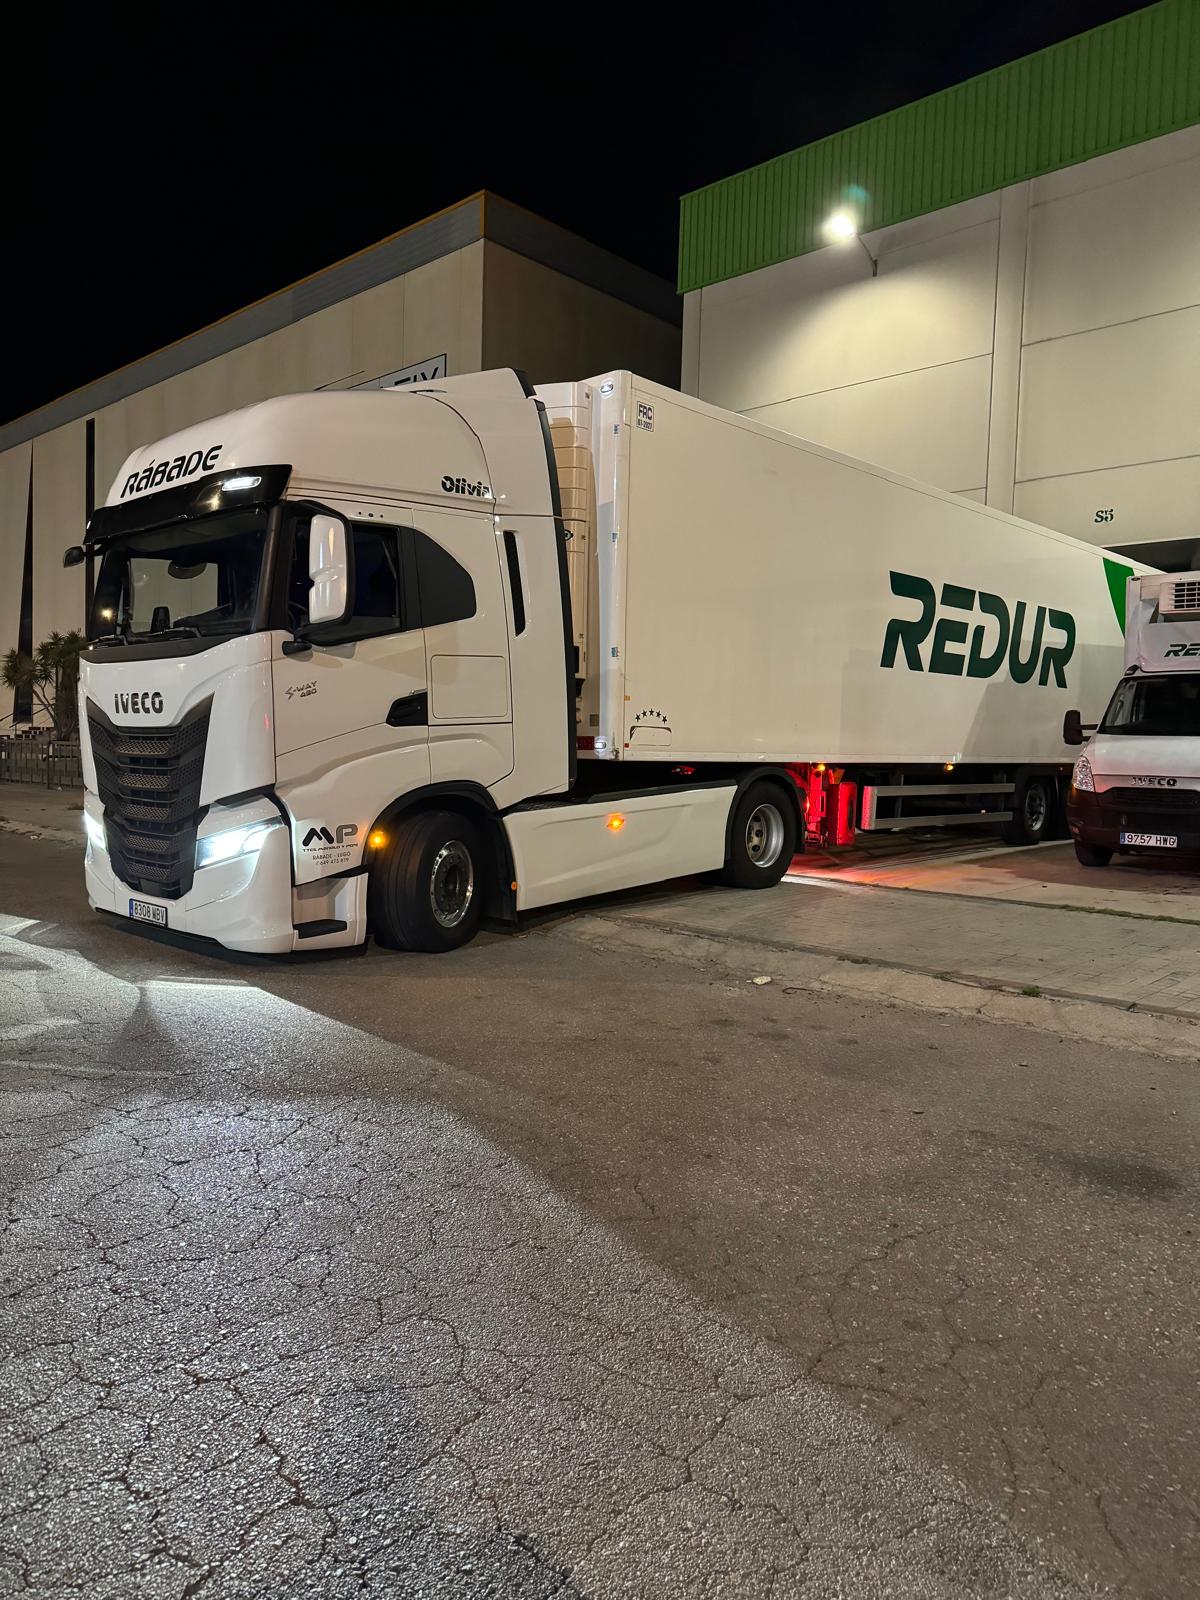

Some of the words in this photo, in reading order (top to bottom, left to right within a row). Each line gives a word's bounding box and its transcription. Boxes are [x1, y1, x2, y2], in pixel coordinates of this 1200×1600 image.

[638, 403, 653, 420] FRC
[120, 444, 223, 499] RÁBADE
[441, 475, 491, 497] Olivia
[1094, 508, 1114, 523] S5
[880, 570, 1076, 689] REDUR
[114, 691, 164, 714] IVECO
[1130, 776, 1178, 787] IVECO
[302, 823, 359, 847] MP
[1126, 833, 1153, 845] 9757
[1155, 836, 1177, 847] HWG
[134, 902, 151, 918] 8308
